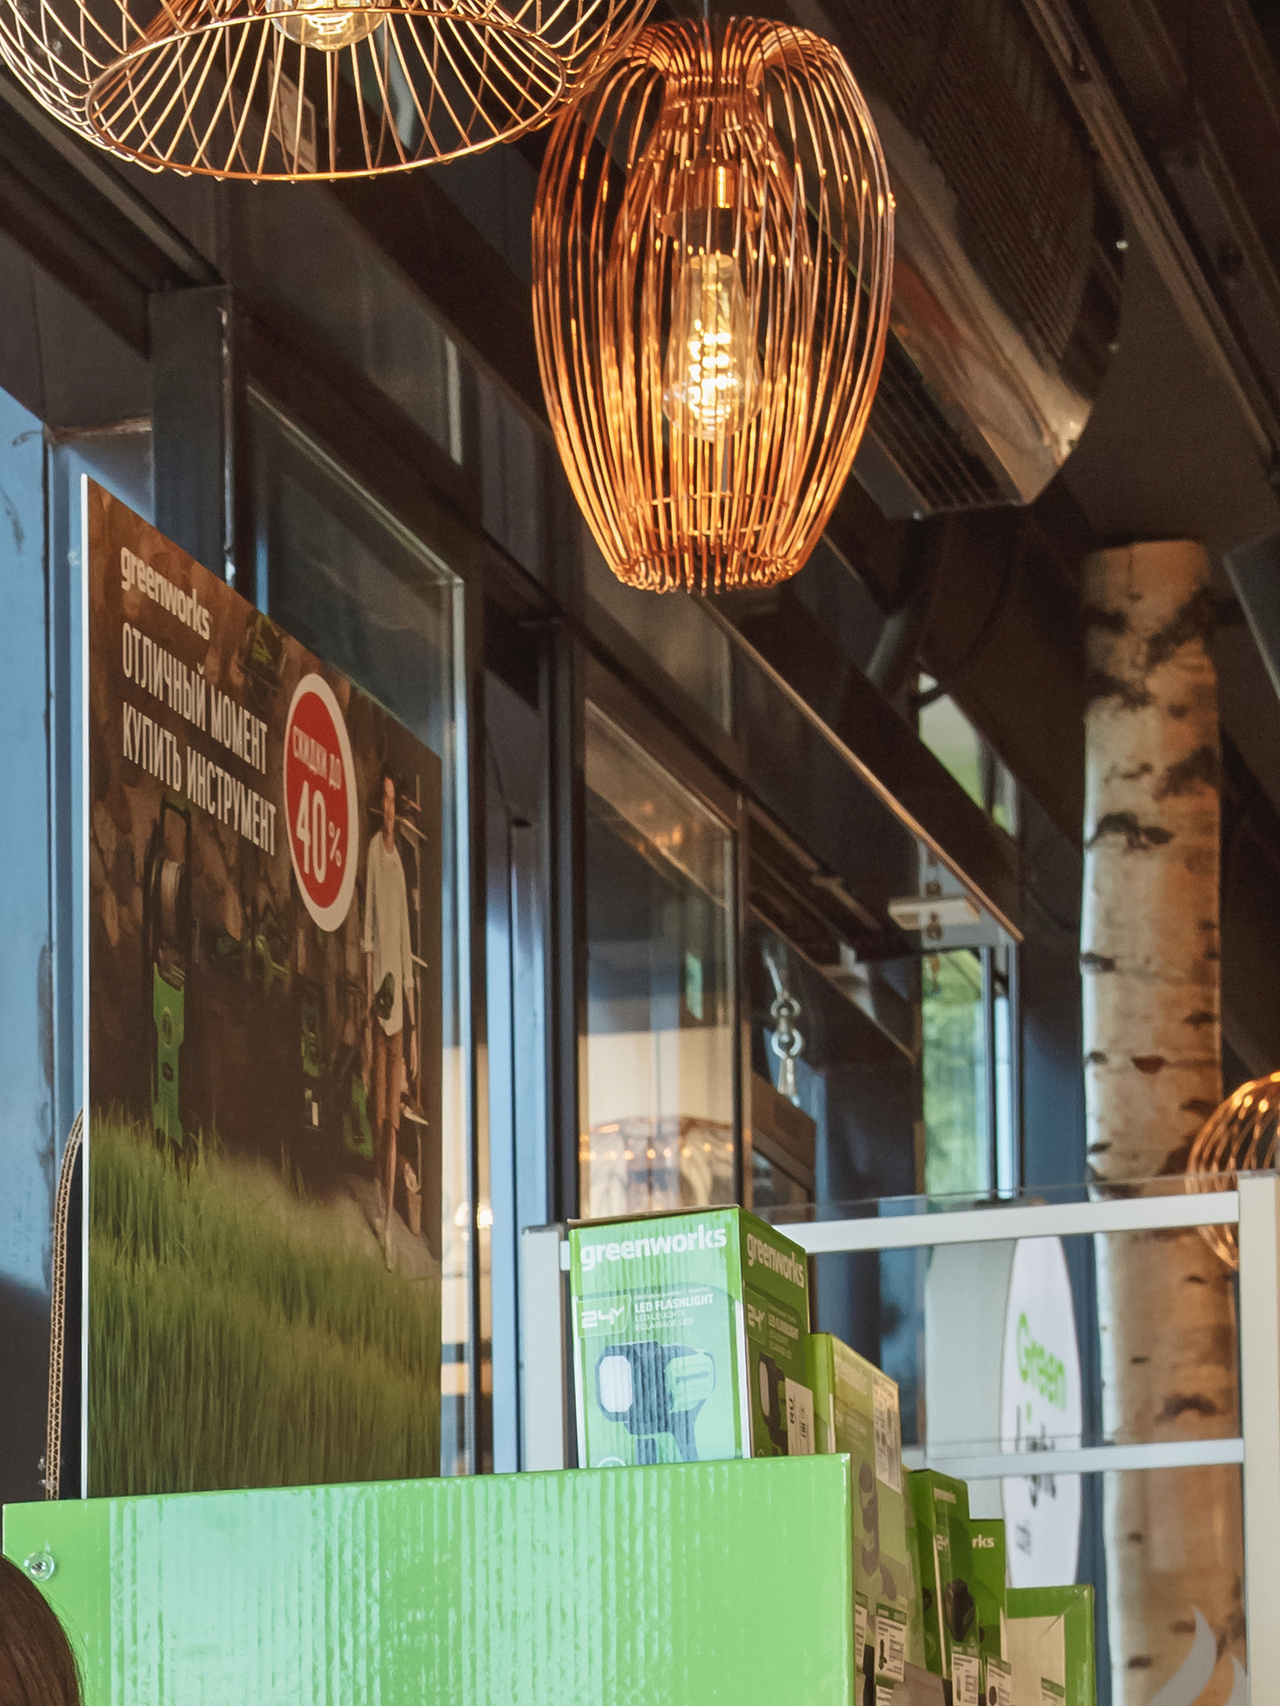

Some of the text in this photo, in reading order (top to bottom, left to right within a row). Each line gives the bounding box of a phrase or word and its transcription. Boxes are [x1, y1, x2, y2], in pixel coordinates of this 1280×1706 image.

[121, 546, 210, 641] greenworks
[122, 622, 267, 775] ОТЛИЧНЫЙ МОМЕНТ
[123, 701, 276, 856] КУПИТЬ ИНСТРУМЕНТ
[581, 1224, 727, 1271] greenworks
[747, 1232, 805, 1288] greenworks
[634, 1294, 714, 1313] LED FLASHLIGHT
